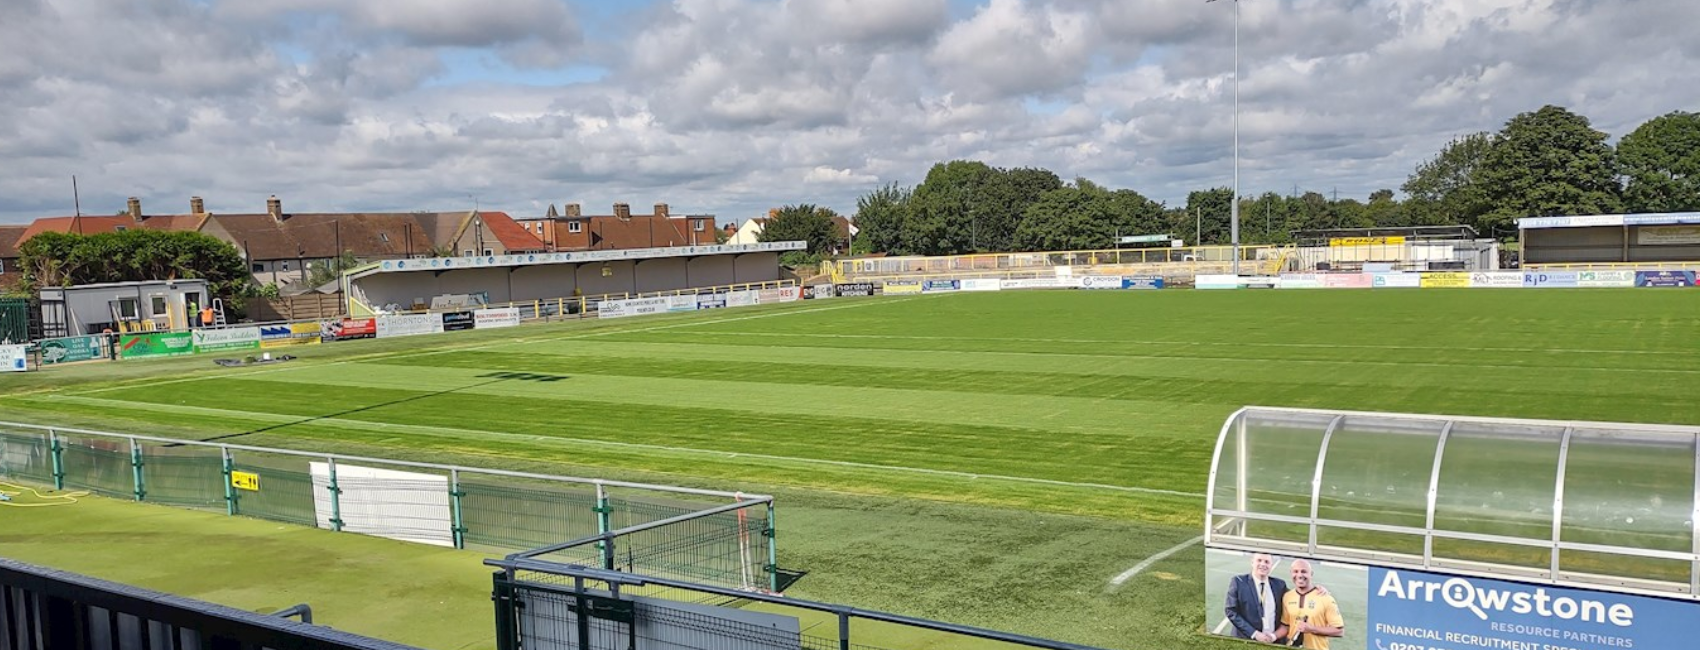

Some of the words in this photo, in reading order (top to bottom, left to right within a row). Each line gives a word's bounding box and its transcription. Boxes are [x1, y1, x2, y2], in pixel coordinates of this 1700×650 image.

[387, 315, 433, 326] THORNTONS
[1378, 571, 1633, 626] Arrowstone
[1376, 623, 1443, 641] FINANCIAL
[1445, 632, 1540, 650] RECRUITMENT
[1491, 621, 1560, 639] RESOURCE
[1563, 630, 1633, 648] PARTNERS
